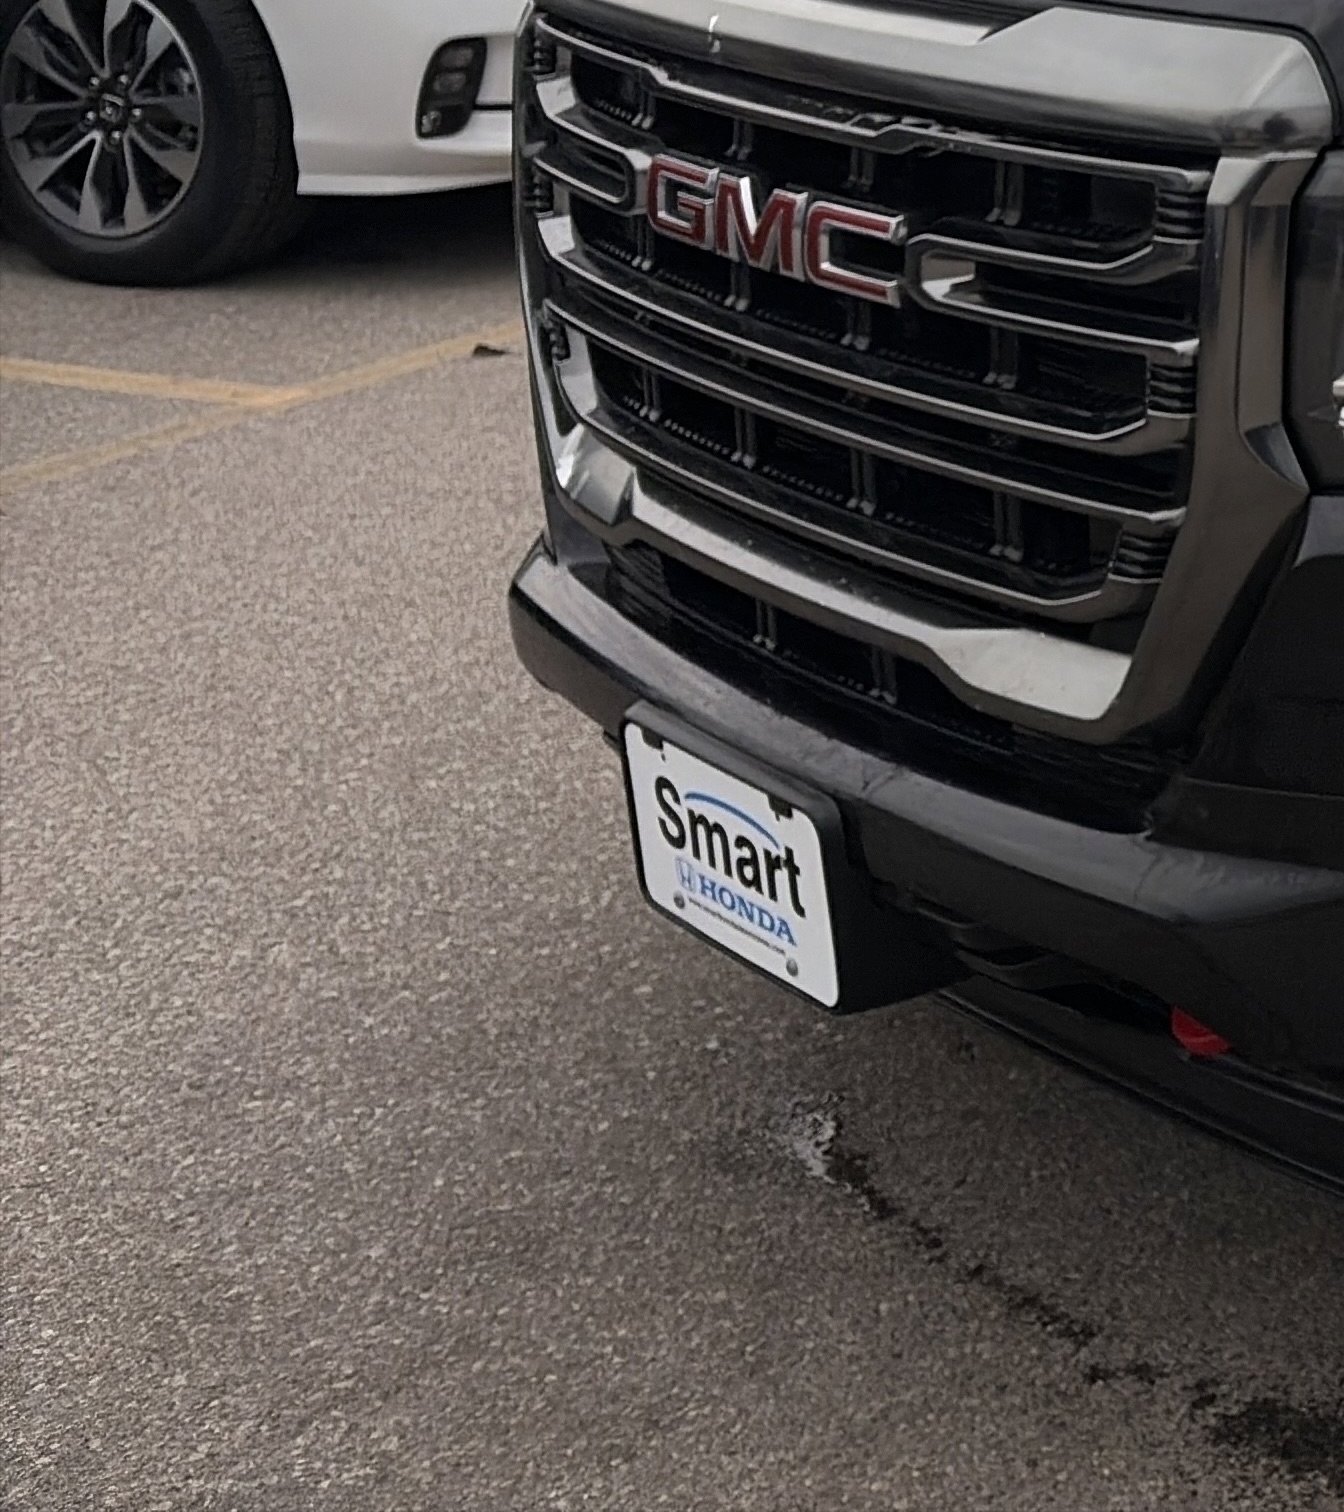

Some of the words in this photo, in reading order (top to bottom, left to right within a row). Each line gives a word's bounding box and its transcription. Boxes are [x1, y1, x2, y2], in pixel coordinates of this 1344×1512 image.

[648, 153, 908, 309] GMC
[654, 775, 807, 919] Smart
[697, 874, 798, 947] HONDA
